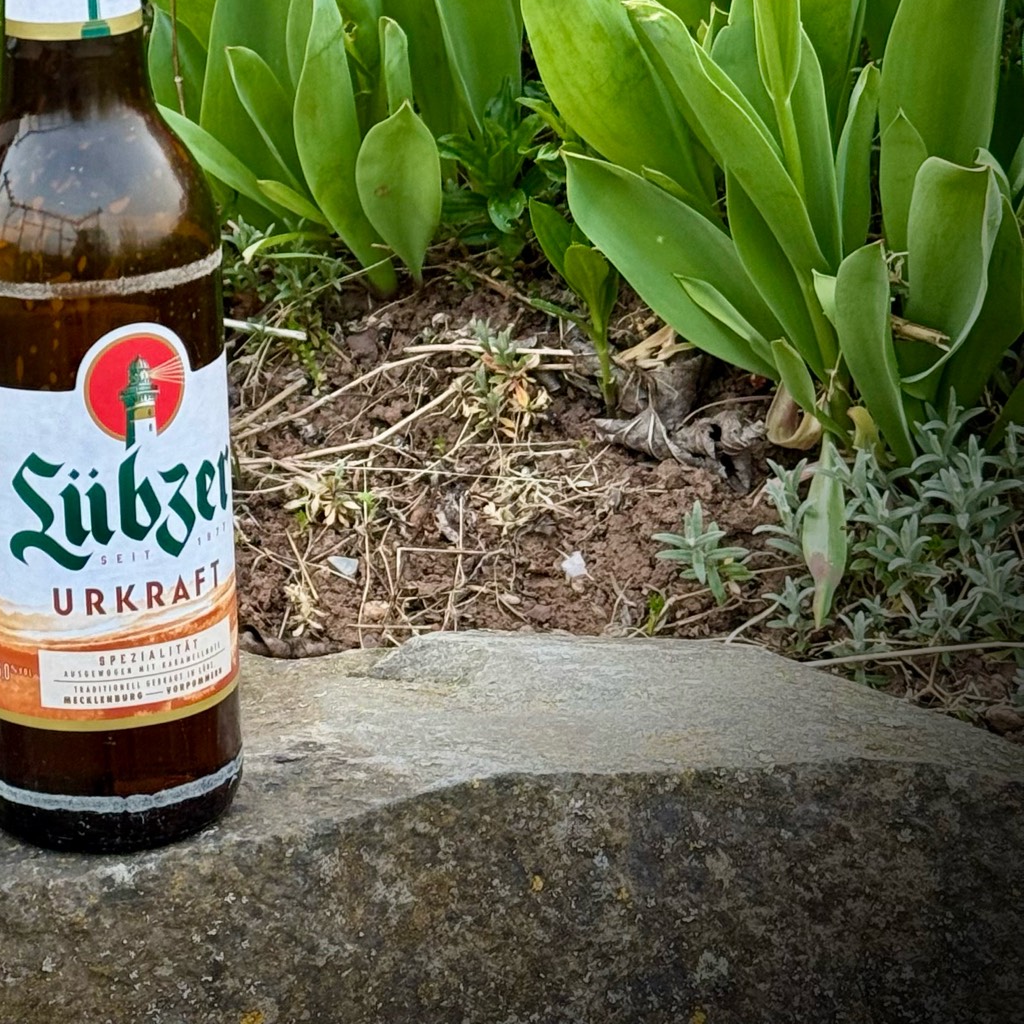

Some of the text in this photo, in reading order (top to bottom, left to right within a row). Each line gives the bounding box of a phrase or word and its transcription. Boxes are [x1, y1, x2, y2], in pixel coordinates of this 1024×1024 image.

[9, 444, 229, 571] Lübzer
[100, 549, 152, 566] SEIT
[52, 559, 220, 616] URKRAFT
[99, 639, 199, 666] SPEZIALITÄT
[63, 667, 132, 678] AUSGEWOGEN
[138, 663, 155, 673] MIT
[63, 667, 223, 705] MECKLENBURG VORPOMMERN
[73, 680, 140, 693] TRADITIONELL
